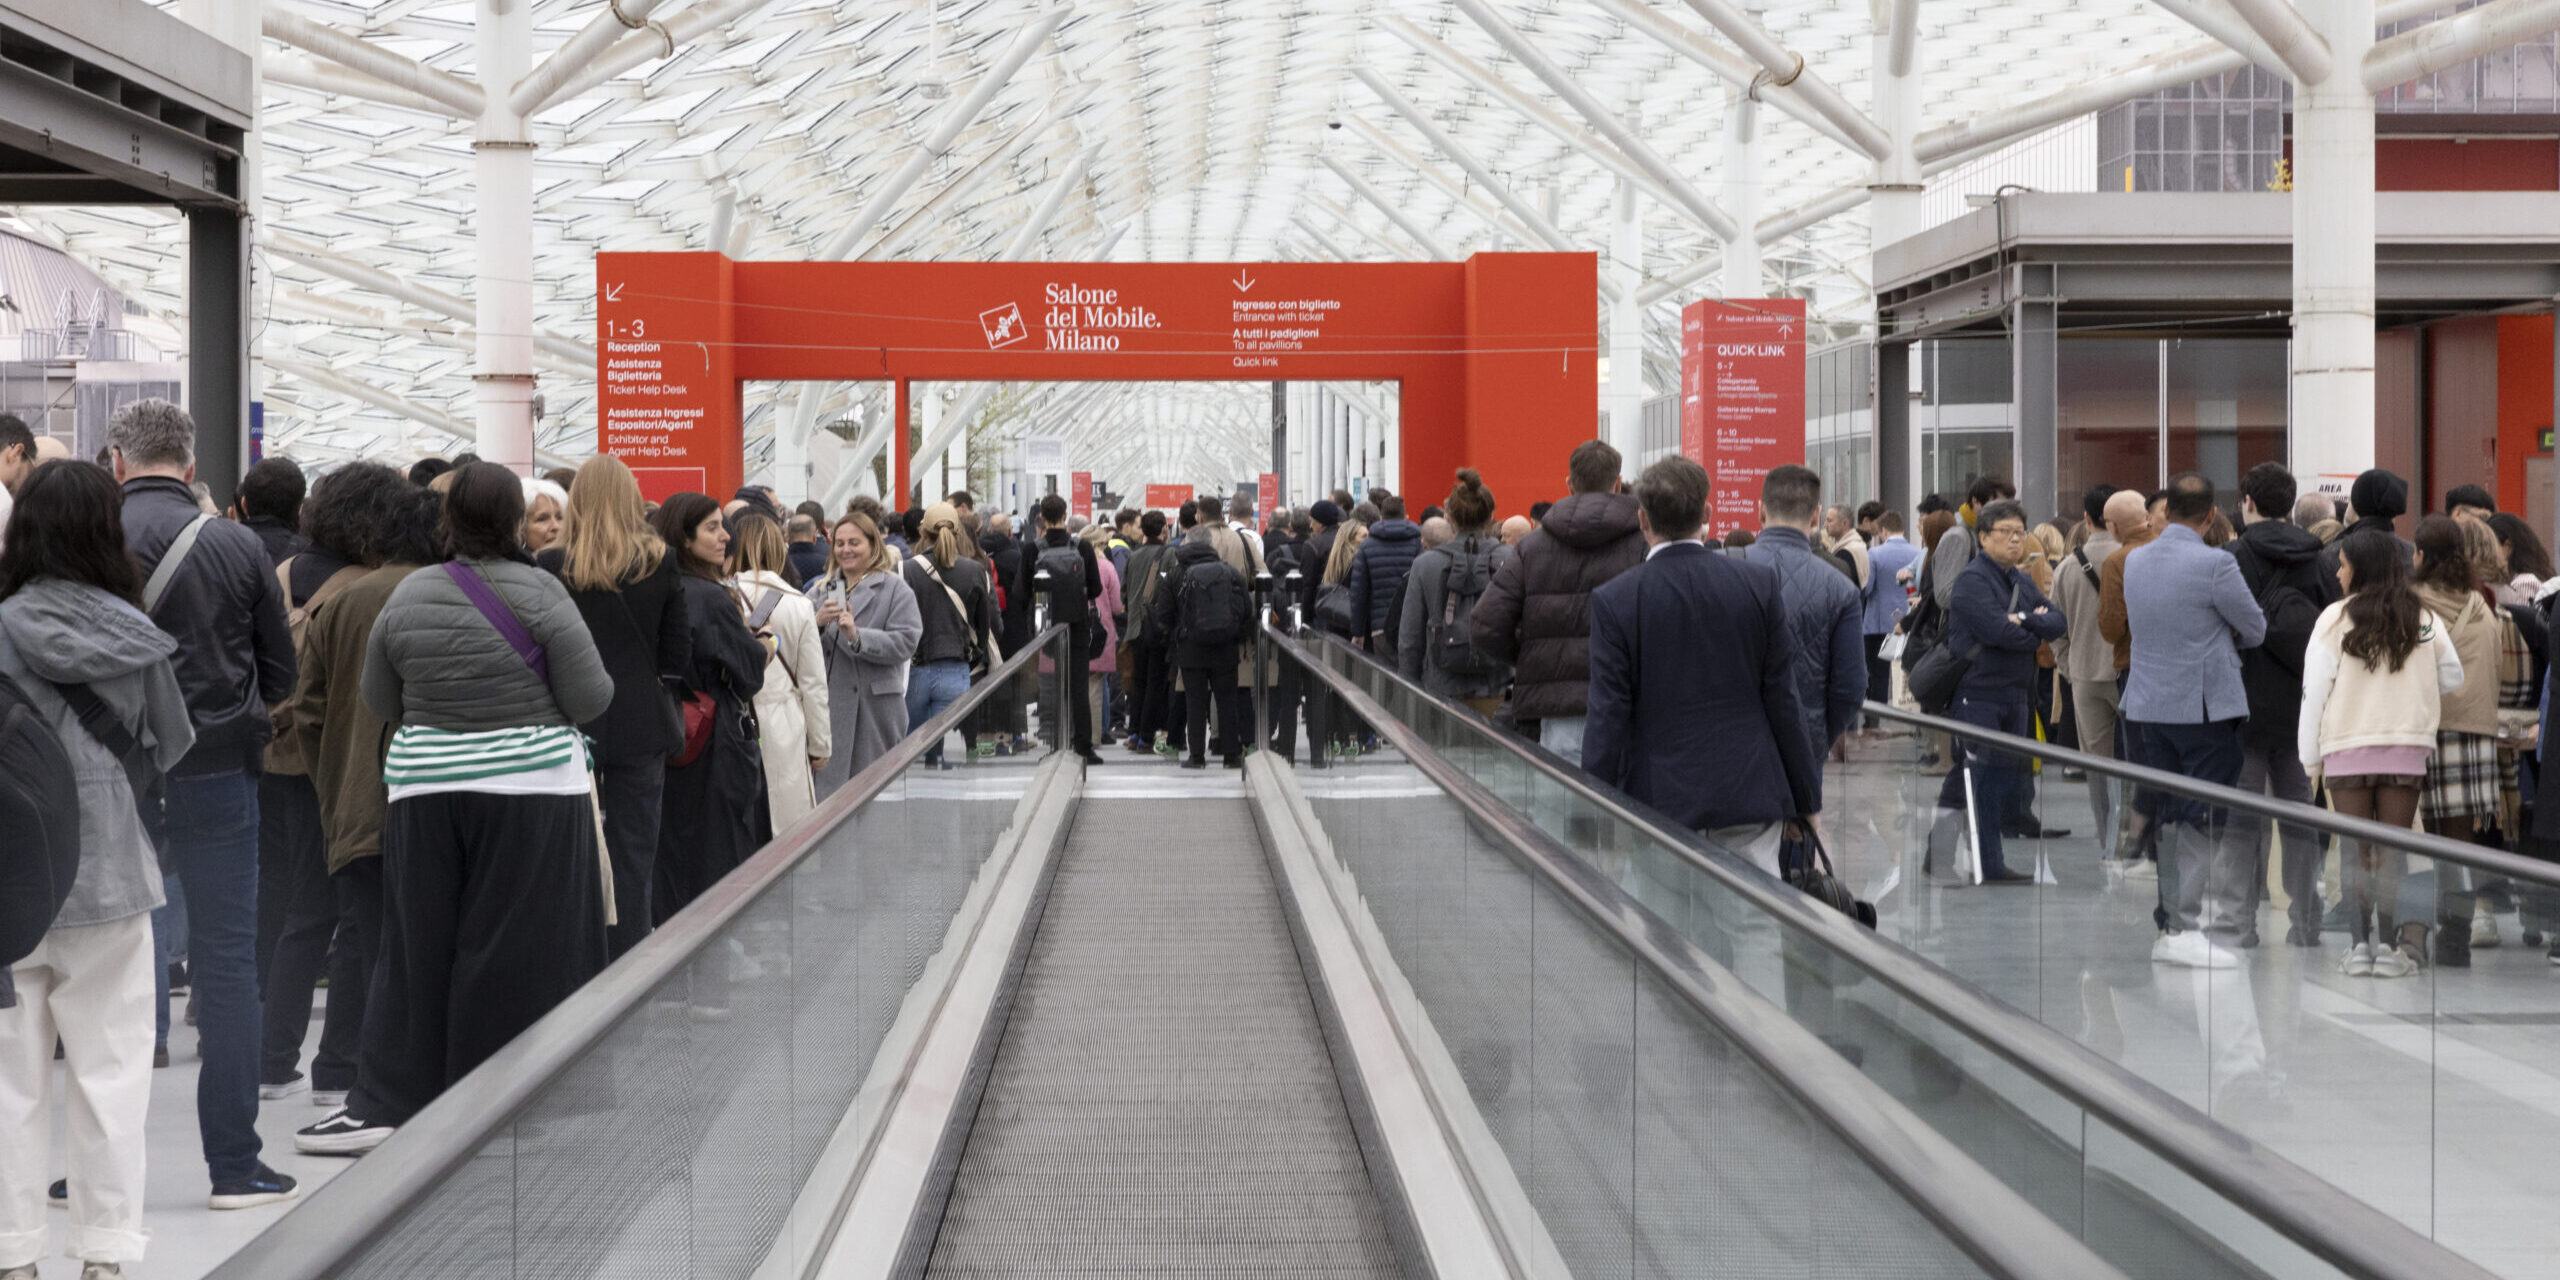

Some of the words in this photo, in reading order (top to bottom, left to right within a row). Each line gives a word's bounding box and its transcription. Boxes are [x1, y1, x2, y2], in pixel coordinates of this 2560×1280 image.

[1045, 282, 1118, 305] Salone
[1232, 300, 1276, 311] Ingresso
[1278, 302, 1297, 310] con
[1299, 300, 1341, 311] biglietto
[1045, 306, 1077, 328] del
[1083, 306, 1161, 328] Mobile.
[1233, 312, 1275, 322] Entrance
[1277, 312, 1297, 322] with
[1299, 312, 1324, 322] ticket
[607, 319, 614, 337] 1
[632, 319, 644, 338] 3
[1232, 328, 1241, 338] A
[1243, 328, 1263, 338] tutti
[1270, 328, 1319, 340] padiglioni
[1045, 329, 1120, 351] Milano
[1233, 340, 1245, 350] To
[1246, 340, 1257, 350] all
[607, 342, 661, 353] Reception
[1717, 345, 1756, 357] QUICK
[1758, 345, 1786, 357] LINK
[607, 358, 662, 369] Assistenza
[1233, 356, 1261, 367] Quick
[1262, 356, 1278, 367] link
[1728, 361, 1734, 370] 7
[607, 370, 662, 382] Biglietteria
[608, 384, 636, 394] Ticket
[638, 384, 660, 395] Help
[662, 384, 687, 394] Desk
[608, 407, 662, 417] Assistenza
[664, 407, 704, 419] Ingressi
[608, 420, 693, 431] Espositori/Agenti
[1729, 428, 1737, 436] 10
[608, 434, 648, 444] Exhibitor
[650, 434, 669, 444] and
[608, 447, 636, 457] Agent
[638, 446, 660, 457] Help
[662, 446, 687, 456] Desk
[1728, 459, 1735, 467] 11
[2319, 484, 2342, 493] AREA
[1717, 521, 1725, 529] 14
